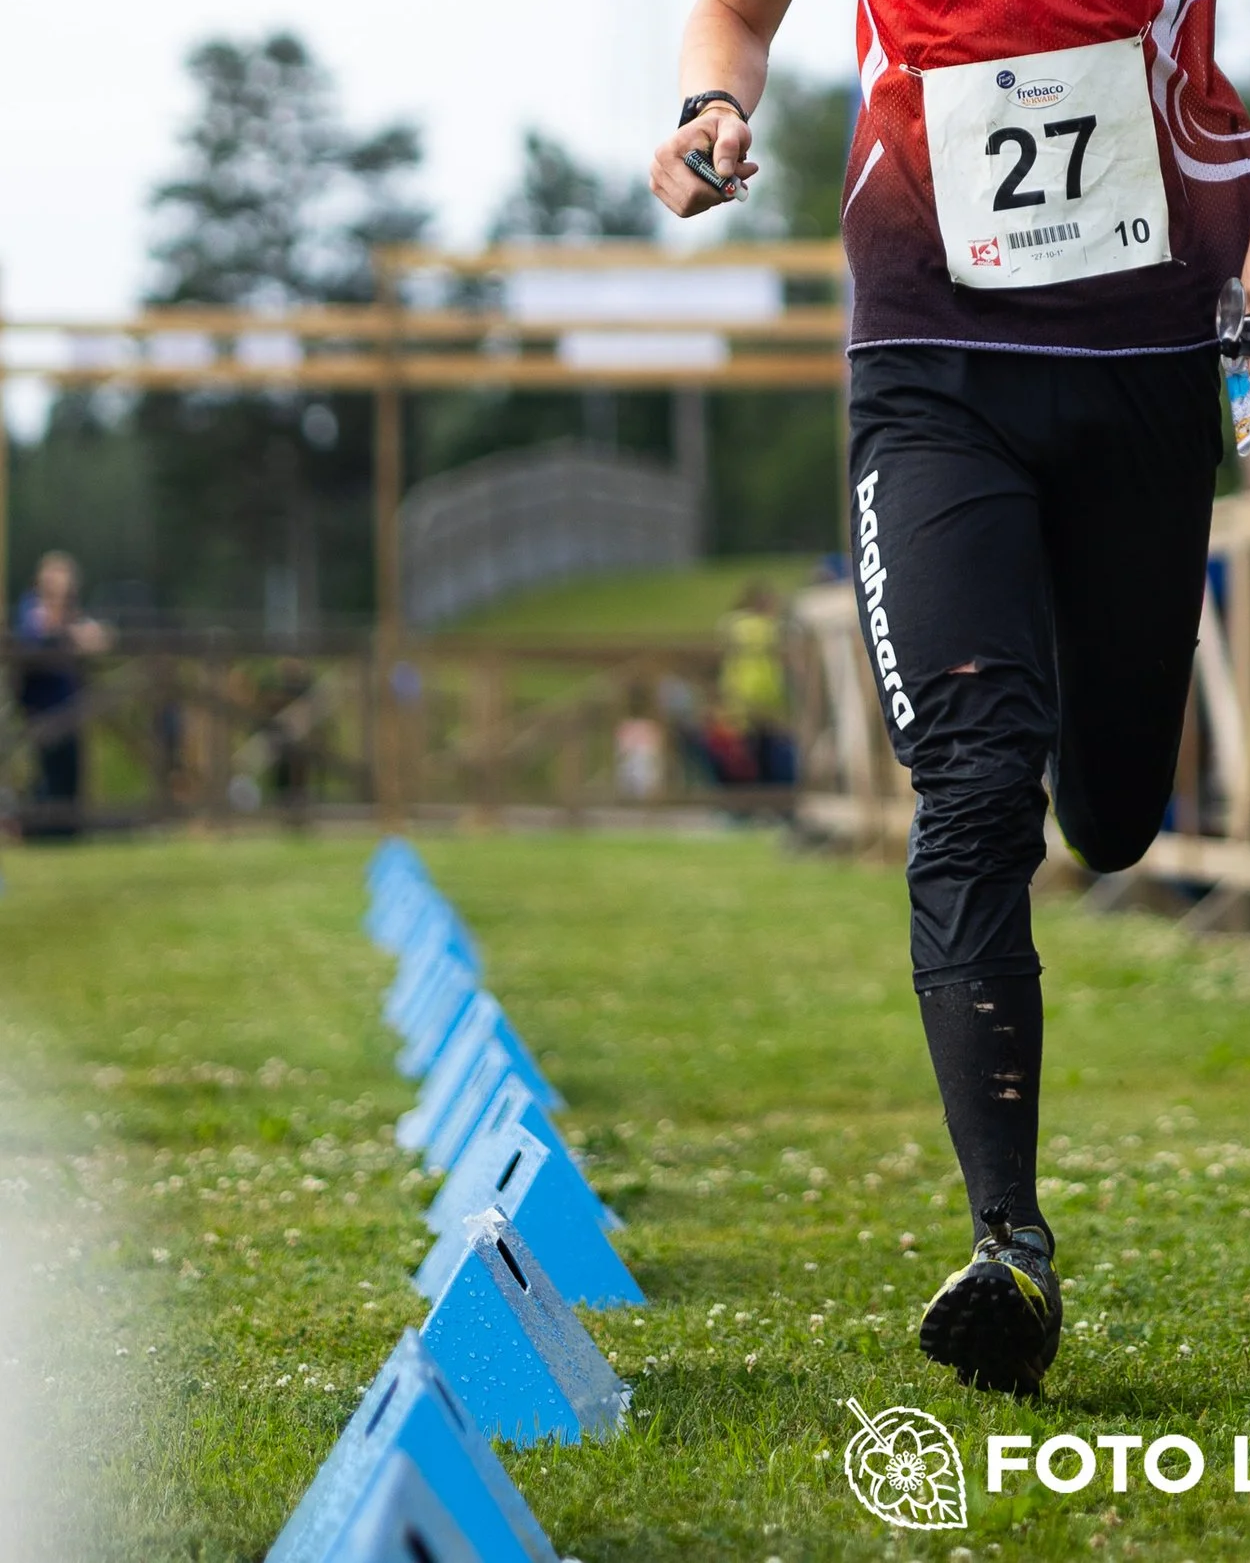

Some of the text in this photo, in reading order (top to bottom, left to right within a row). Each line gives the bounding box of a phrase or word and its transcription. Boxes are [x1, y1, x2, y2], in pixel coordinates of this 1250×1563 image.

[1016, 83, 1064, 99] frebaco
[985, 114, 1097, 212] 27
[1114, 217, 1151, 247] 10
[856, 469, 916, 731] bagheera
